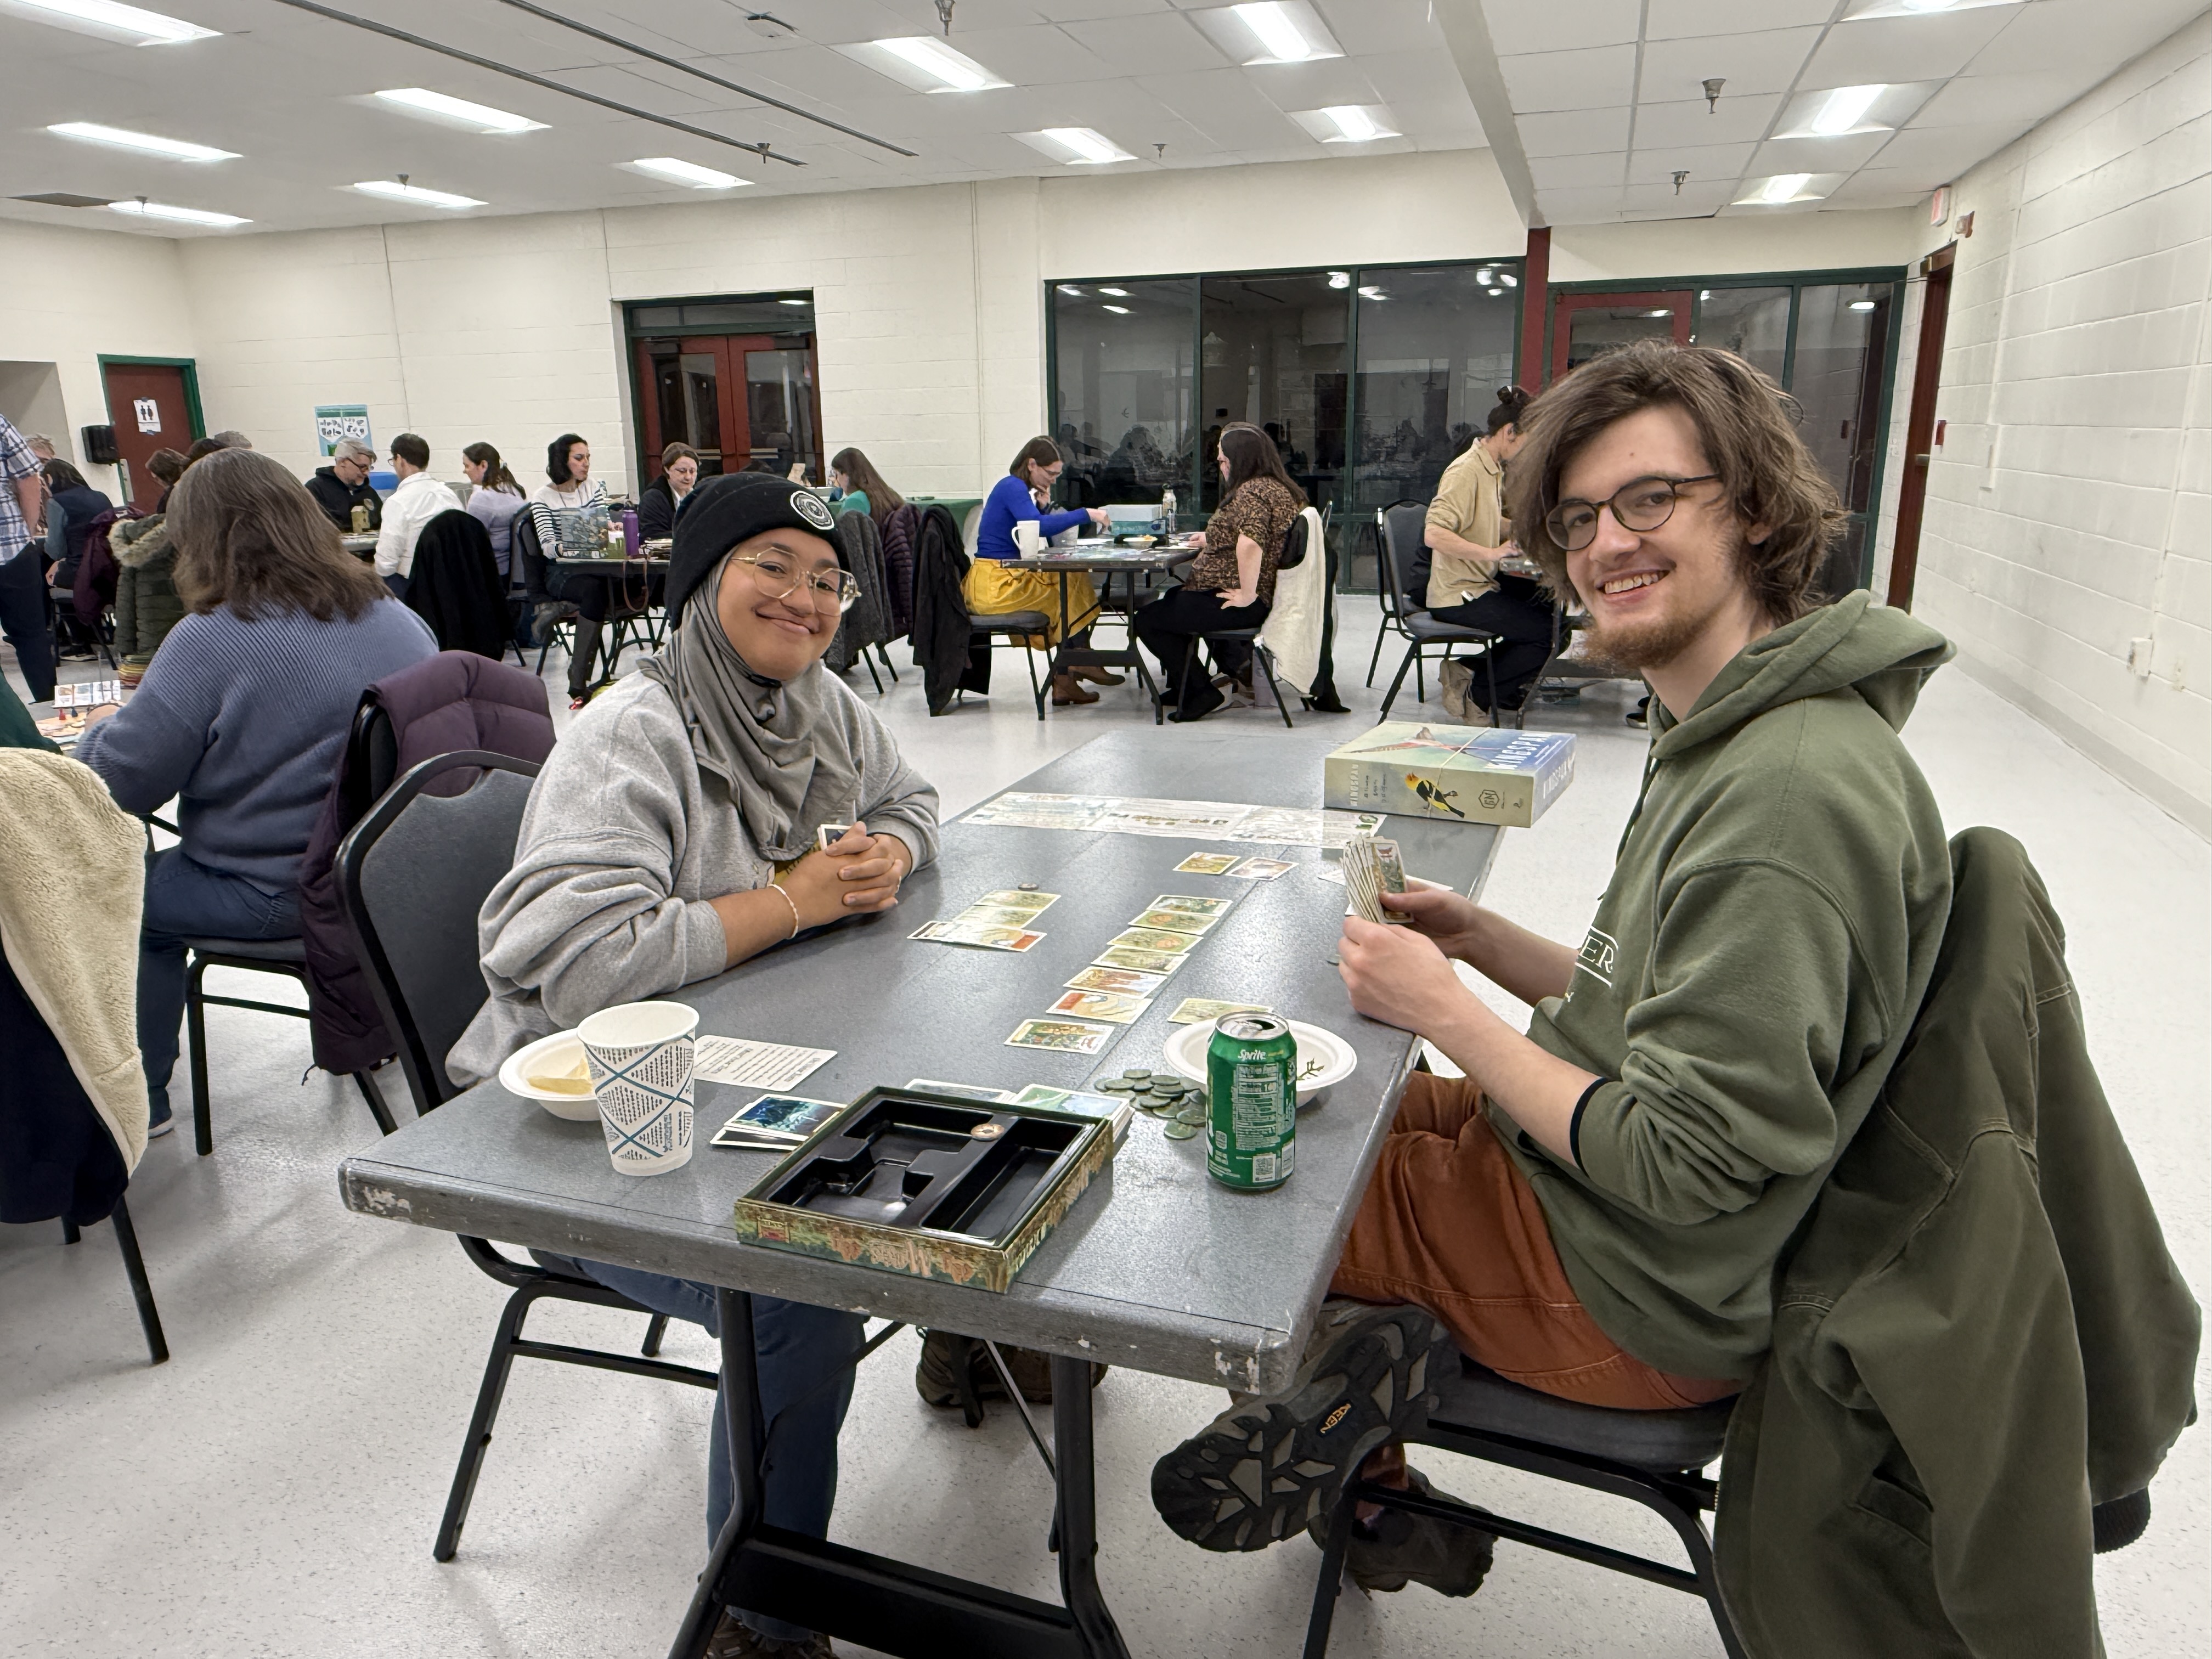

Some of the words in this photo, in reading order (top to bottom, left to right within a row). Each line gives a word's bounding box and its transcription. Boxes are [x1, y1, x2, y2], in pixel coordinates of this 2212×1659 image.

[1483, 733, 1552, 770] WINGSPAN
[1237, 1049, 1266, 1062] Sprite
[1320, 1403, 1351, 1434] KEEN
